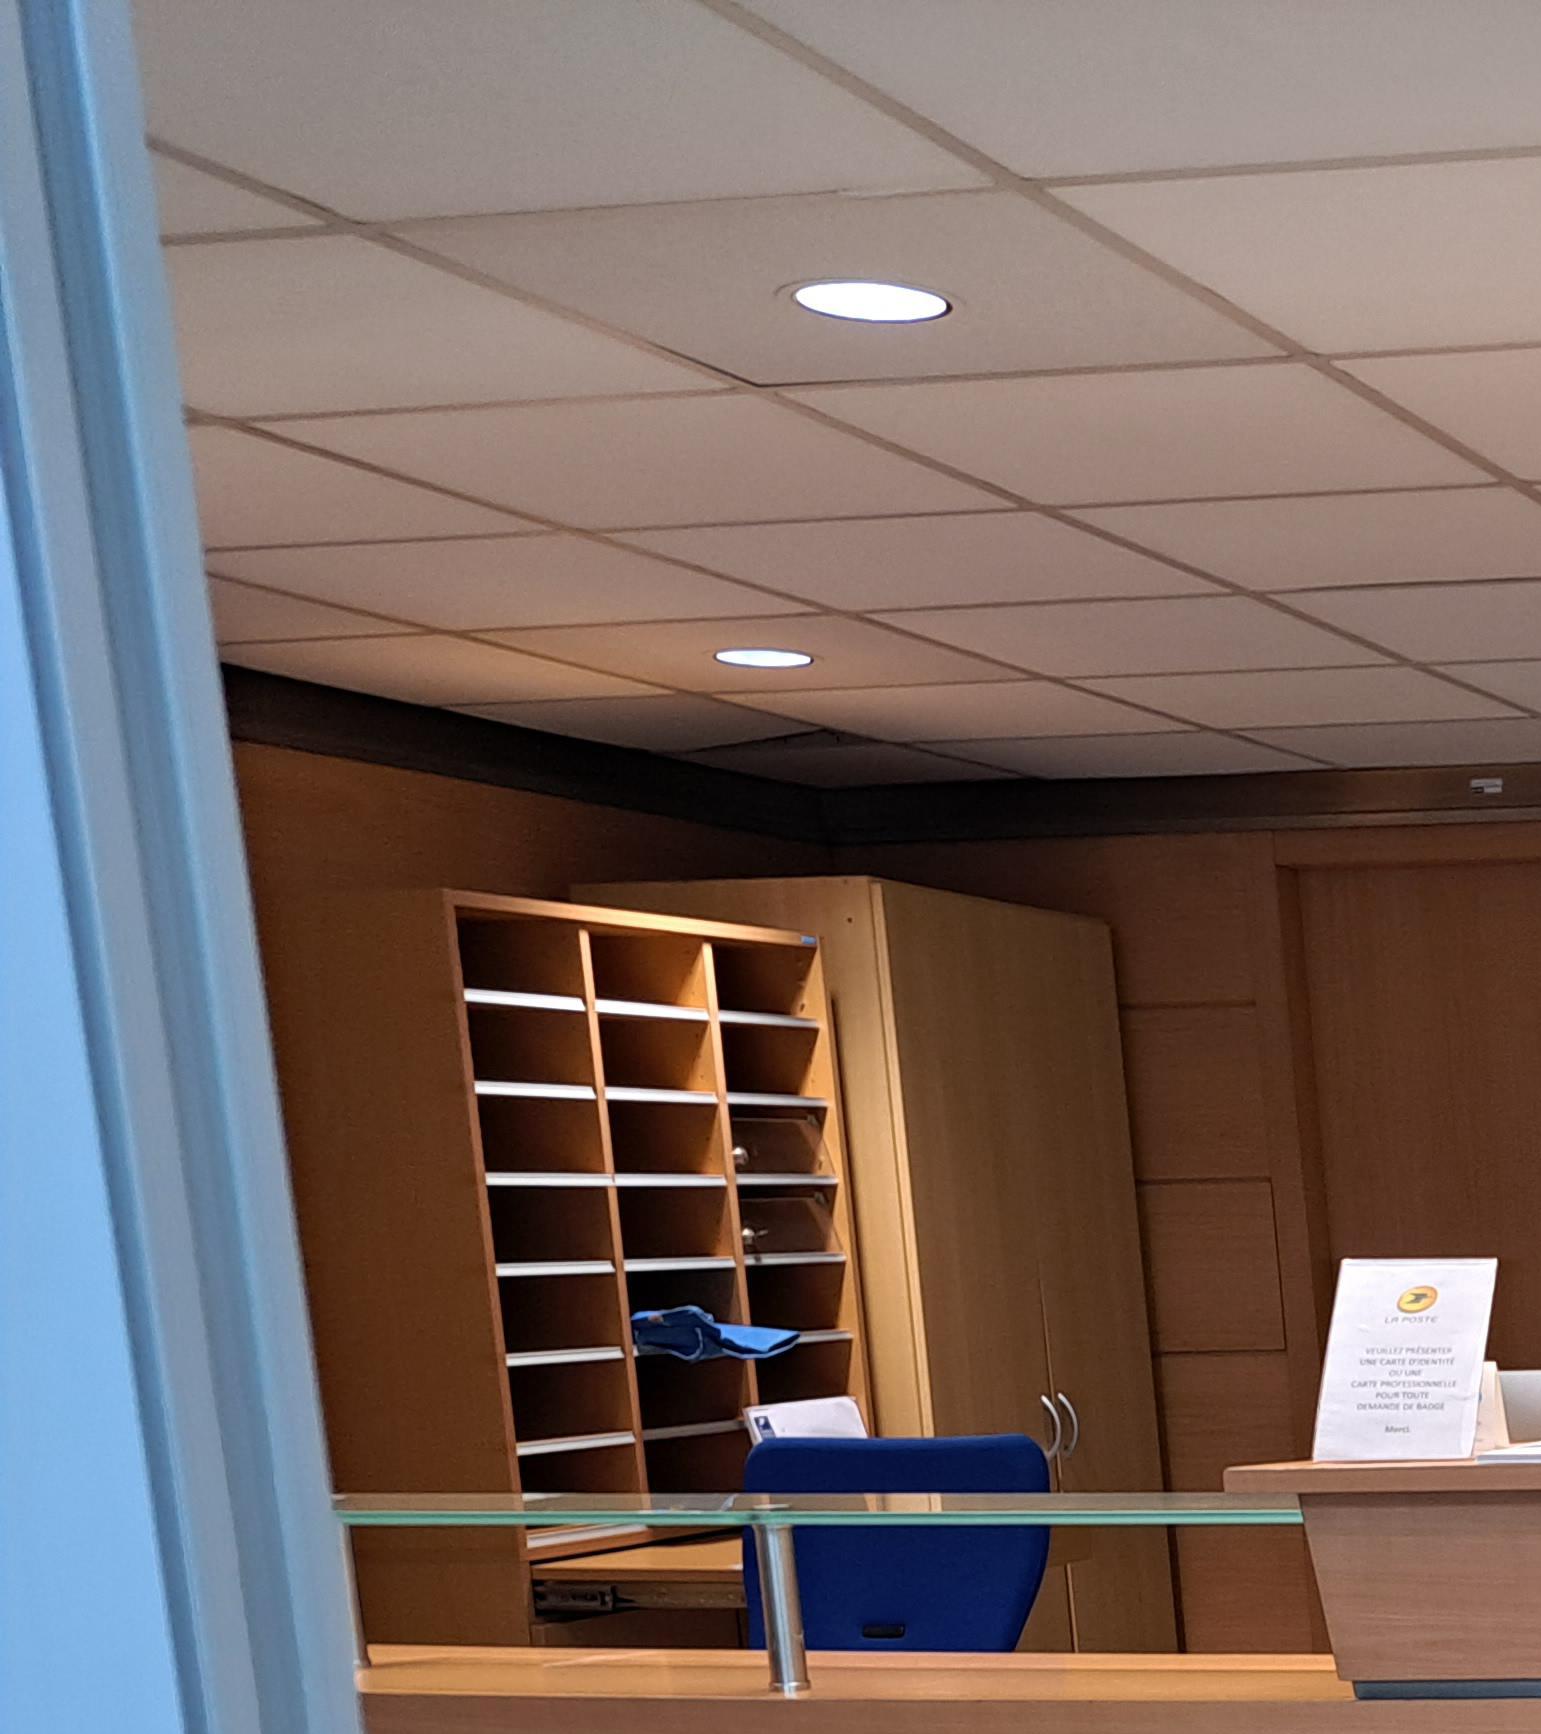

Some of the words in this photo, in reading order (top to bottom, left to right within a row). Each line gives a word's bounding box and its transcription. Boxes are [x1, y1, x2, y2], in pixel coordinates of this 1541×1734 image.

[1384, 1316, 1400, 1324] LA
[1401, 1316, 1439, 1324] POSTE
[1365, 1347, 1404, 1355] VEUILLEZ
[1360, 1358, 1377, 1366] UNE
[1379, 1358, 1406, 1366] CARTE
[1388, 1369, 1402, 1377] OU
[1404, 1369, 1422, 1377] UNE
[1351, 1380, 1377, 1388] CARTE
[1375, 1391, 1400, 1400] POUR
[1401, 1391, 1430, 1400] TOUTE
[1356, 1402, 1400, 1411] DEMANDE
[1402, 1402, 1414, 1411] DE
[1416, 1402, 1445, 1411] BADGE
